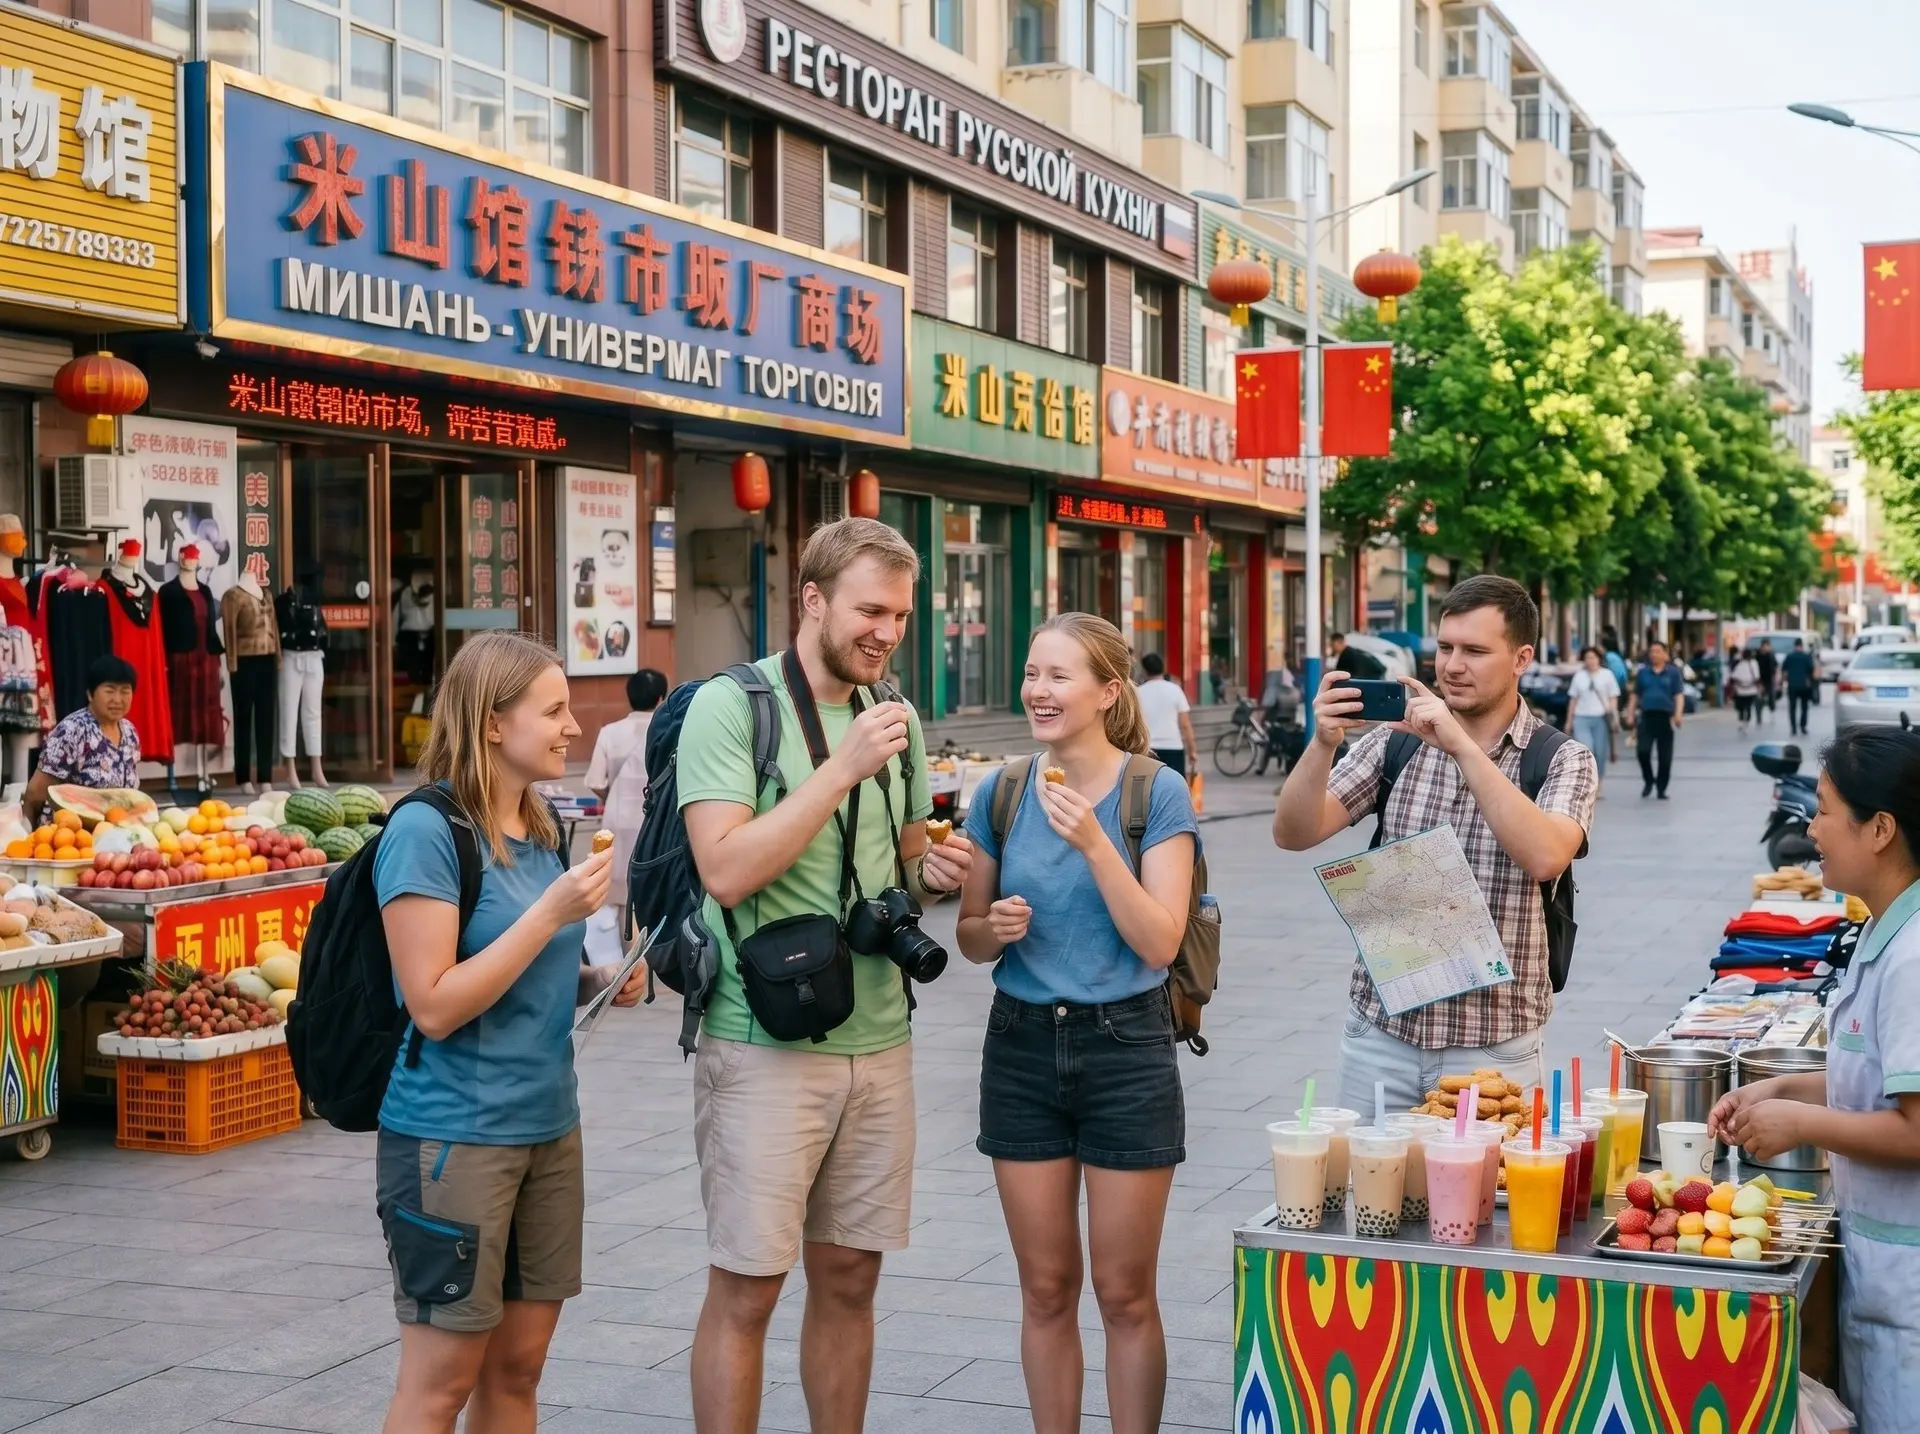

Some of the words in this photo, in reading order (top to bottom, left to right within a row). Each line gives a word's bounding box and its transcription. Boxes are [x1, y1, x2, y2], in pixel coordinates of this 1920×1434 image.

[767, 17, 947, 148] РЕСТОРАН
[956, 108, 1077, 204] РУССКОЙ
[1083, 170, 1157, 242] КУХНИ
[284, 257, 492, 344] МИШАНЬ
[520, 308, 731, 389] УНИВЕРМАГ
[741, 354, 884, 419] ТОРГОВЛЯ
